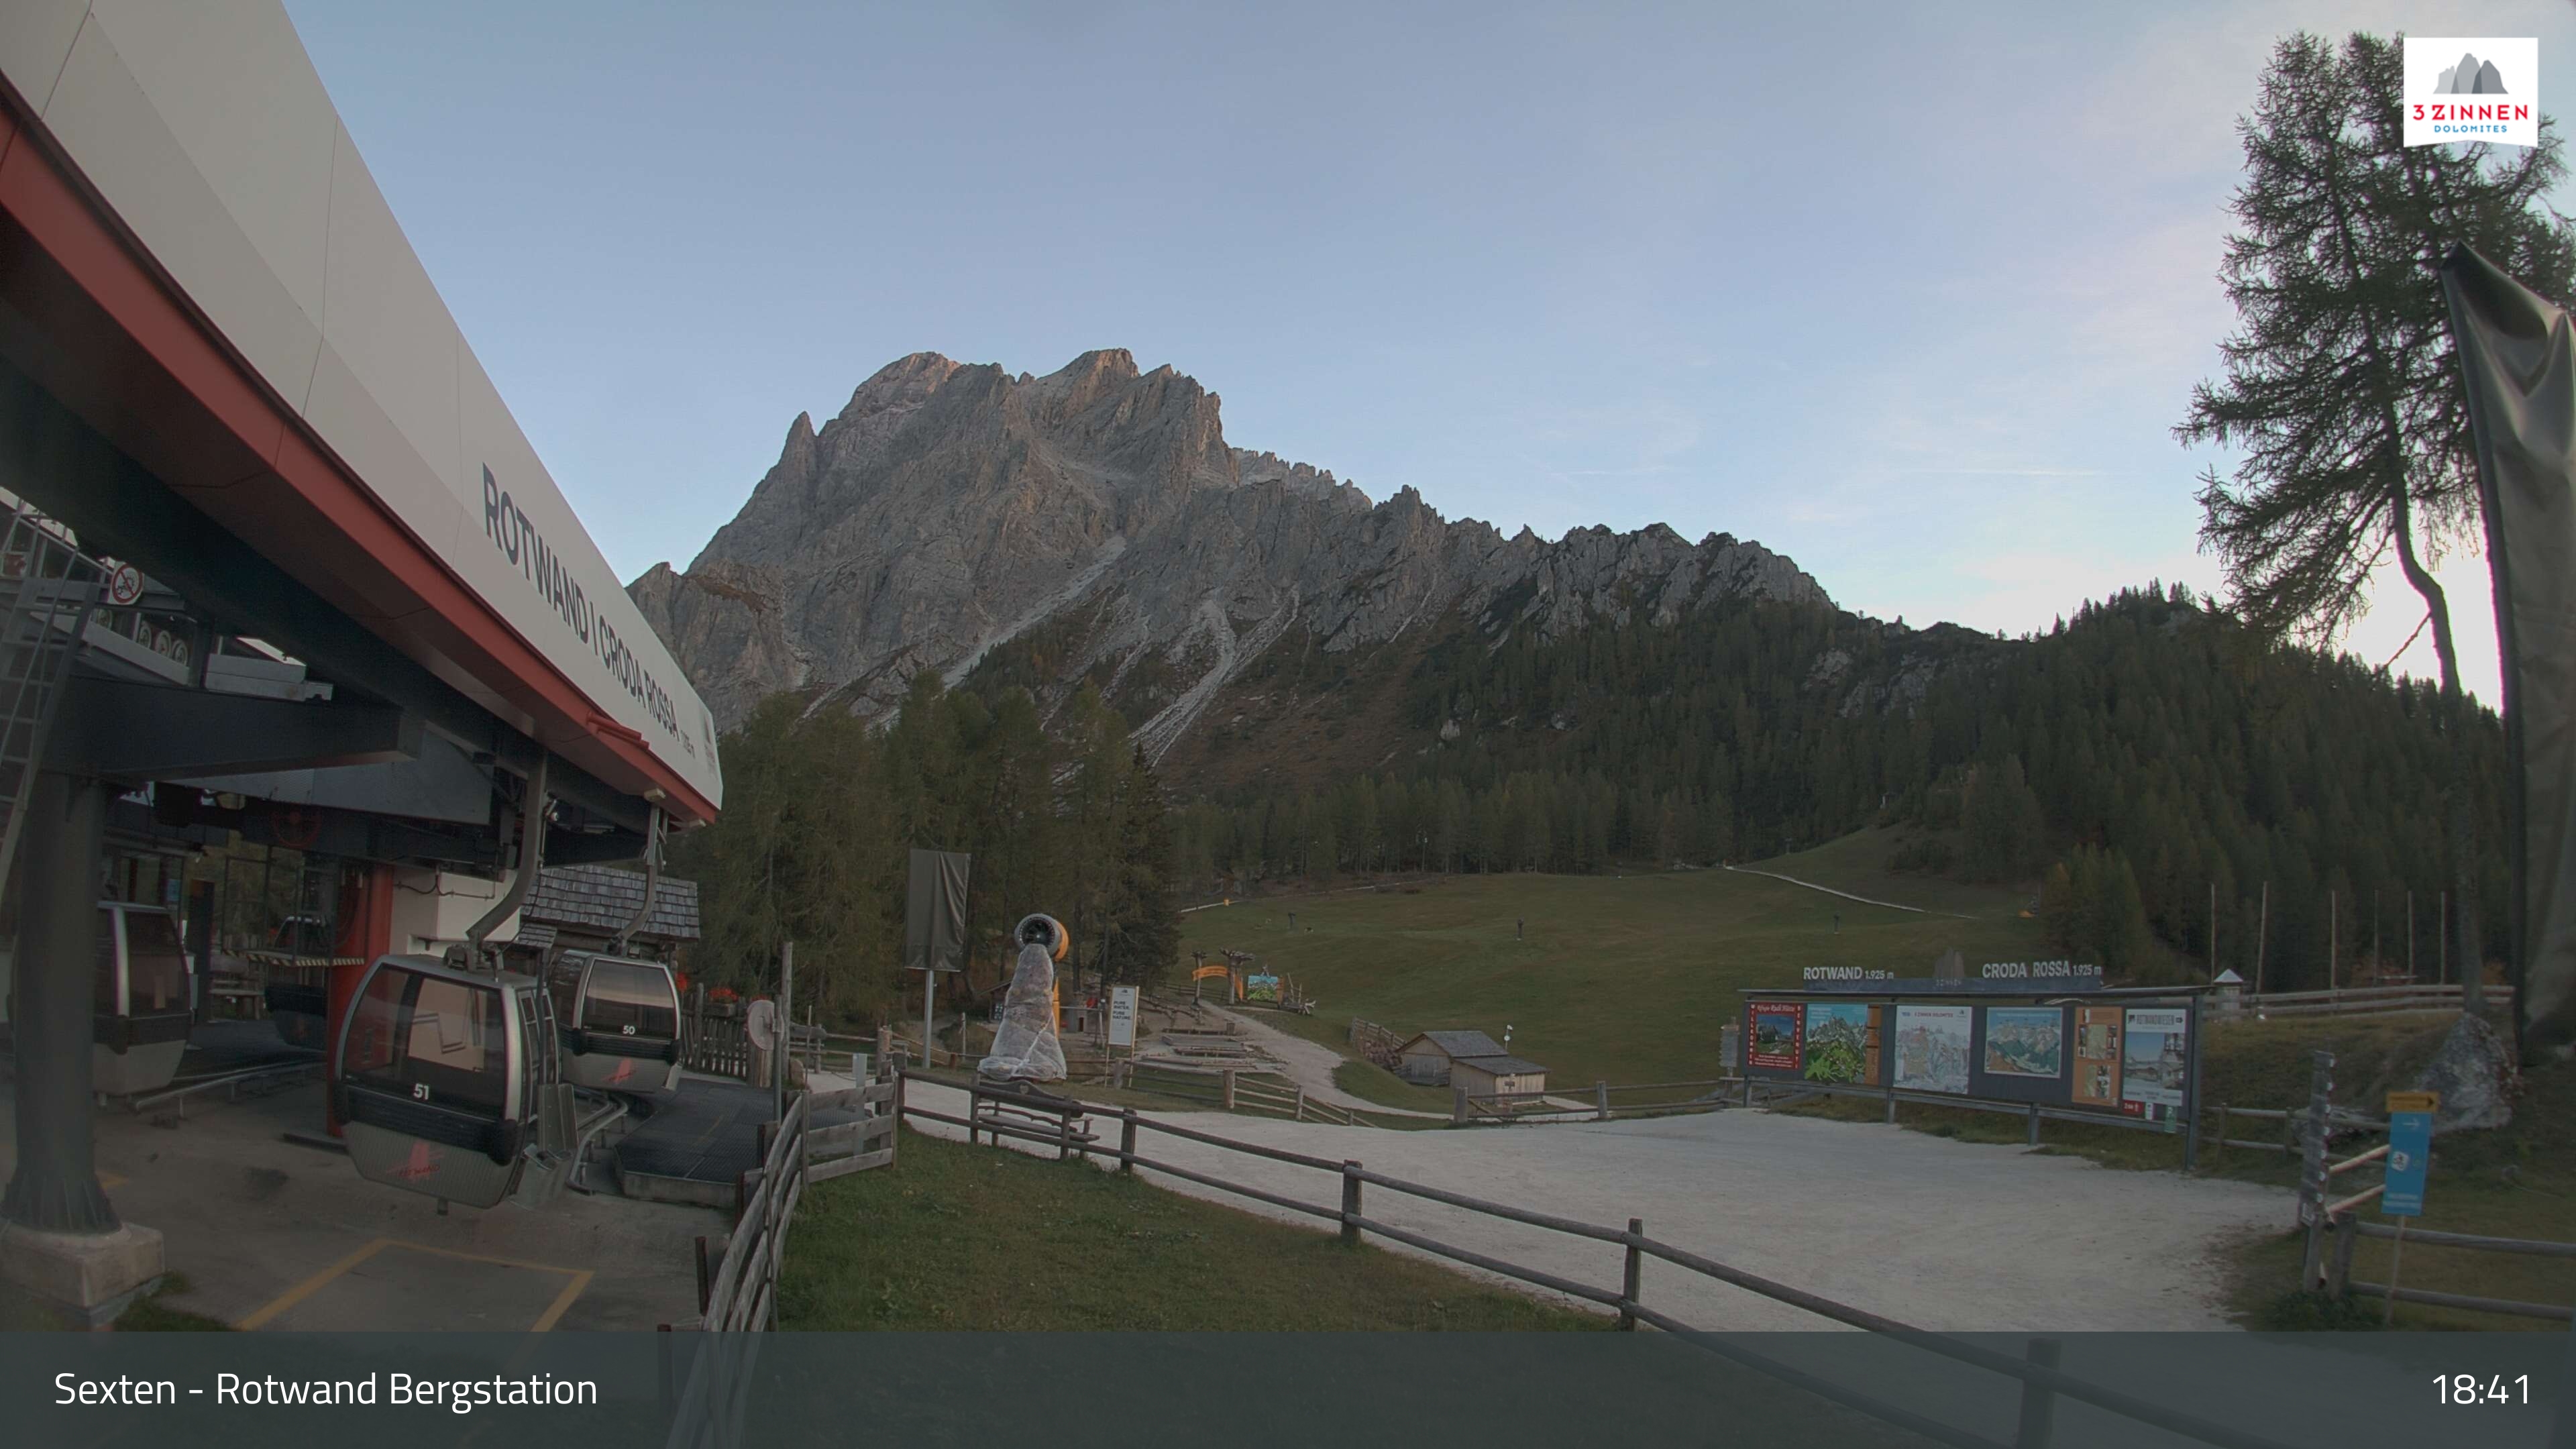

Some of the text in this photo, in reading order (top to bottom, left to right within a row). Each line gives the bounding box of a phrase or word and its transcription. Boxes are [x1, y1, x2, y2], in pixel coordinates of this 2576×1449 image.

[482, 462, 589, 645] ROTWAND
[599, 614, 646, 710] CRODA
[644, 669, 680, 742] ROSSA
[1803, 967, 1863, 980] ROTWAND
[1865, 970, 1886, 980] 1.925
[1982, 961, 2101, 978] CRODA ROSSA 1.925 m
[623, 1025, 635, 1035] 50
[413, 1083, 430, 1100] 51
